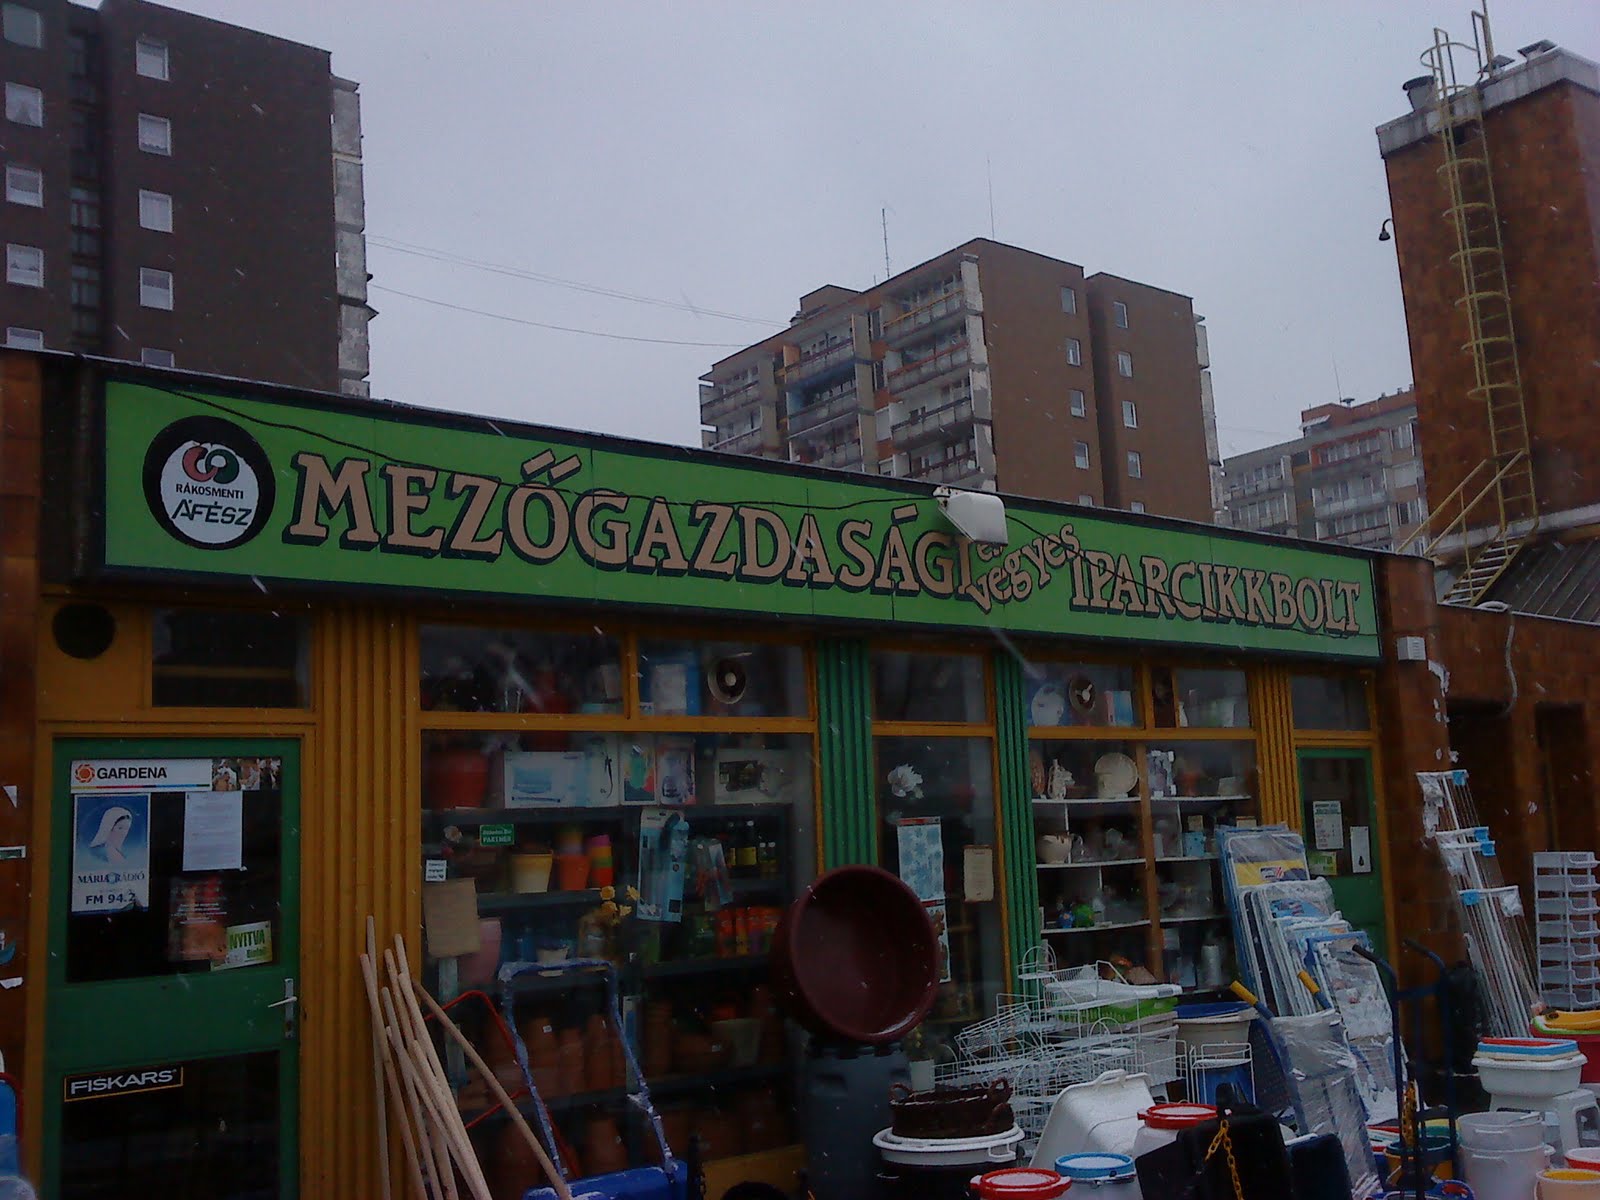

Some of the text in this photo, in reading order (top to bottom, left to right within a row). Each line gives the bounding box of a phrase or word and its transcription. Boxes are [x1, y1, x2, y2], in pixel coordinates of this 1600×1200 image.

[176, 483, 244, 499] RÁKOSMENTI
[171, 499, 252, 526] ÁFÉSZ
[281, 449, 974, 602] MEZŐGAZDASÁGI
[1069, 549, 1360, 638] IPARCIKKBOLT
[96, 767, 167, 779] GARDENA
[77, 872, 109, 884] MÁRIA
[86, 895, 103, 904] FM
[70, 1069, 174, 1095] FISKARS
